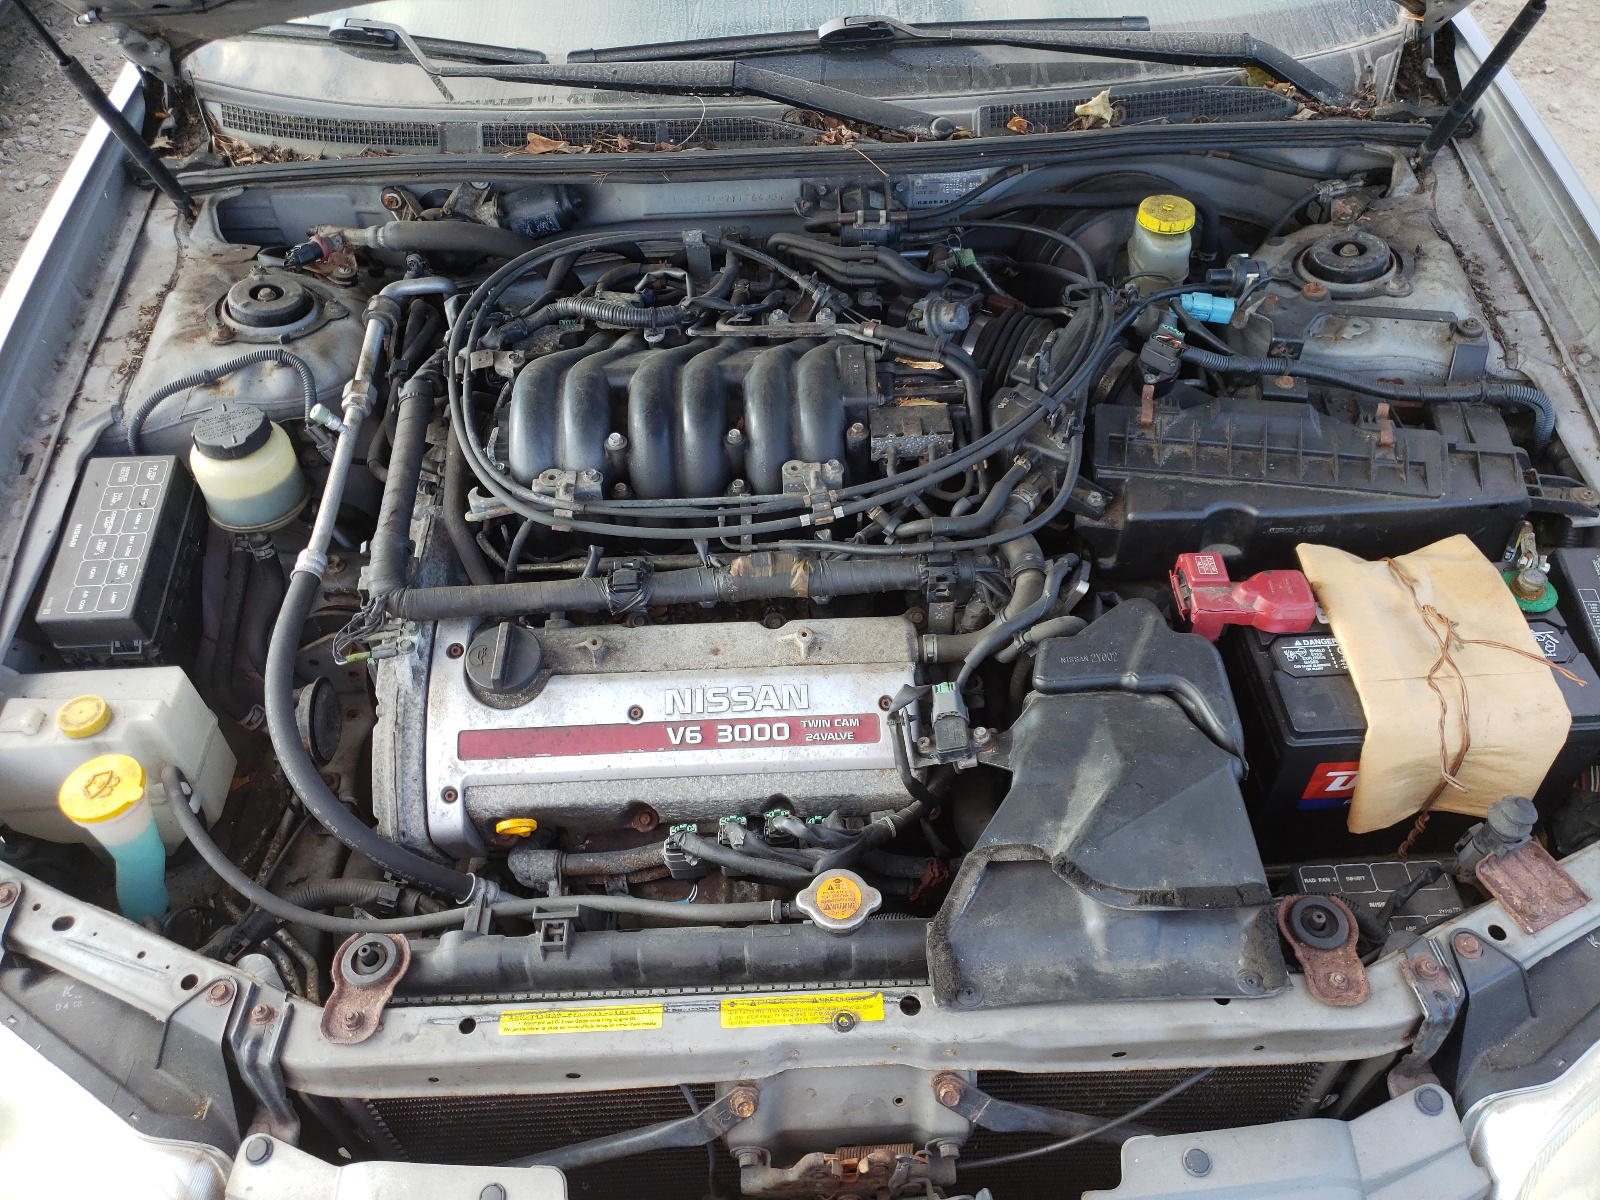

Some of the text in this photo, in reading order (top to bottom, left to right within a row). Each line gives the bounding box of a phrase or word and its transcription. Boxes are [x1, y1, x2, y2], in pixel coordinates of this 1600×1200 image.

[1303, 638, 1339, 646] DANGER
[665, 683, 810, 716] NISSAN
[801, 718, 861, 729] TWIN CAM
[667, 721, 791, 745] V6 3000
[805, 731, 855, 742] 24VALVE
